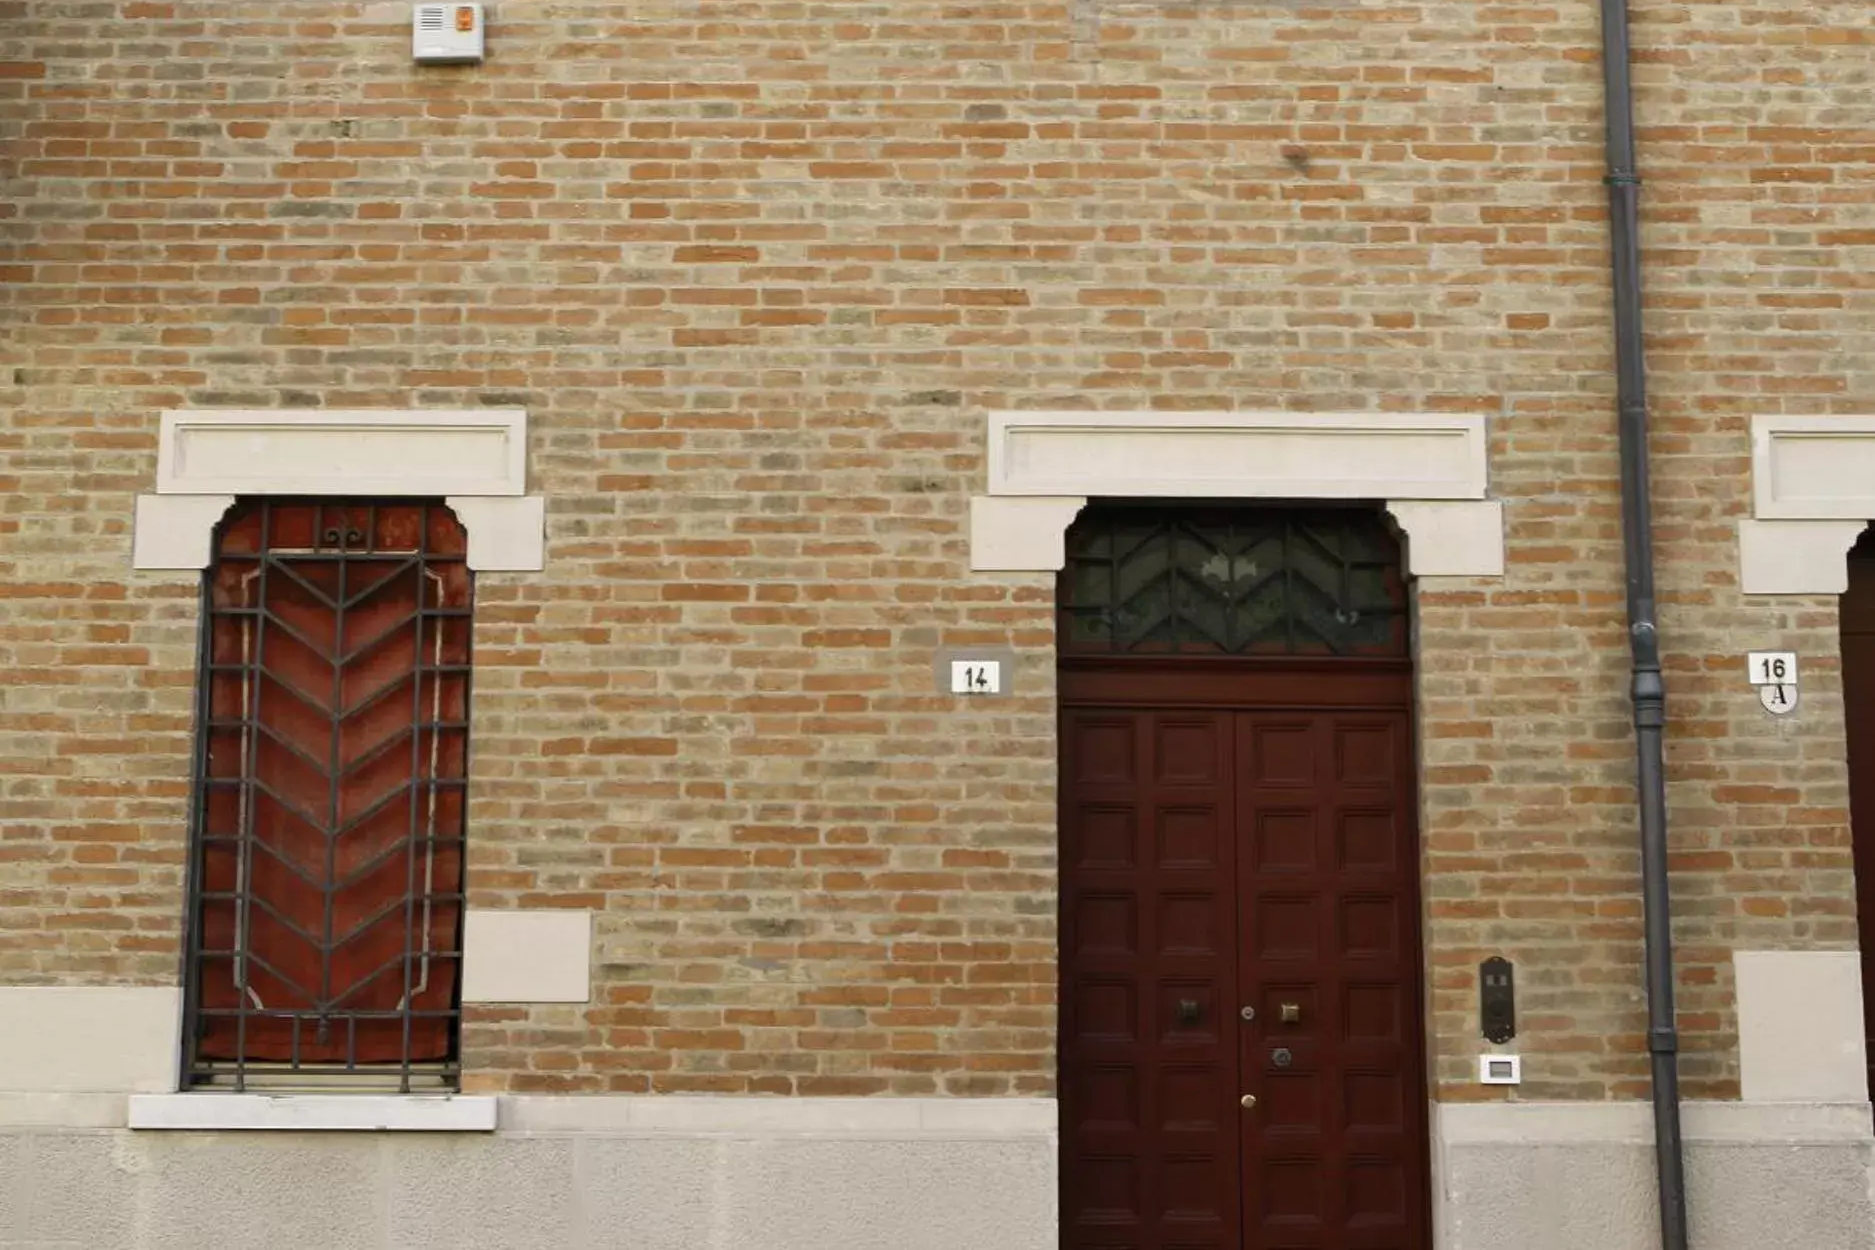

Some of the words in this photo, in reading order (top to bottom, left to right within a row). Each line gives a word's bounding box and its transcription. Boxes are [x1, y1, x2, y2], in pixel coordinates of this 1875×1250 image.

[965, 666, 987, 688] 14
[1761, 658, 1786, 679] 16
[1771, 685, 1787, 705] A
